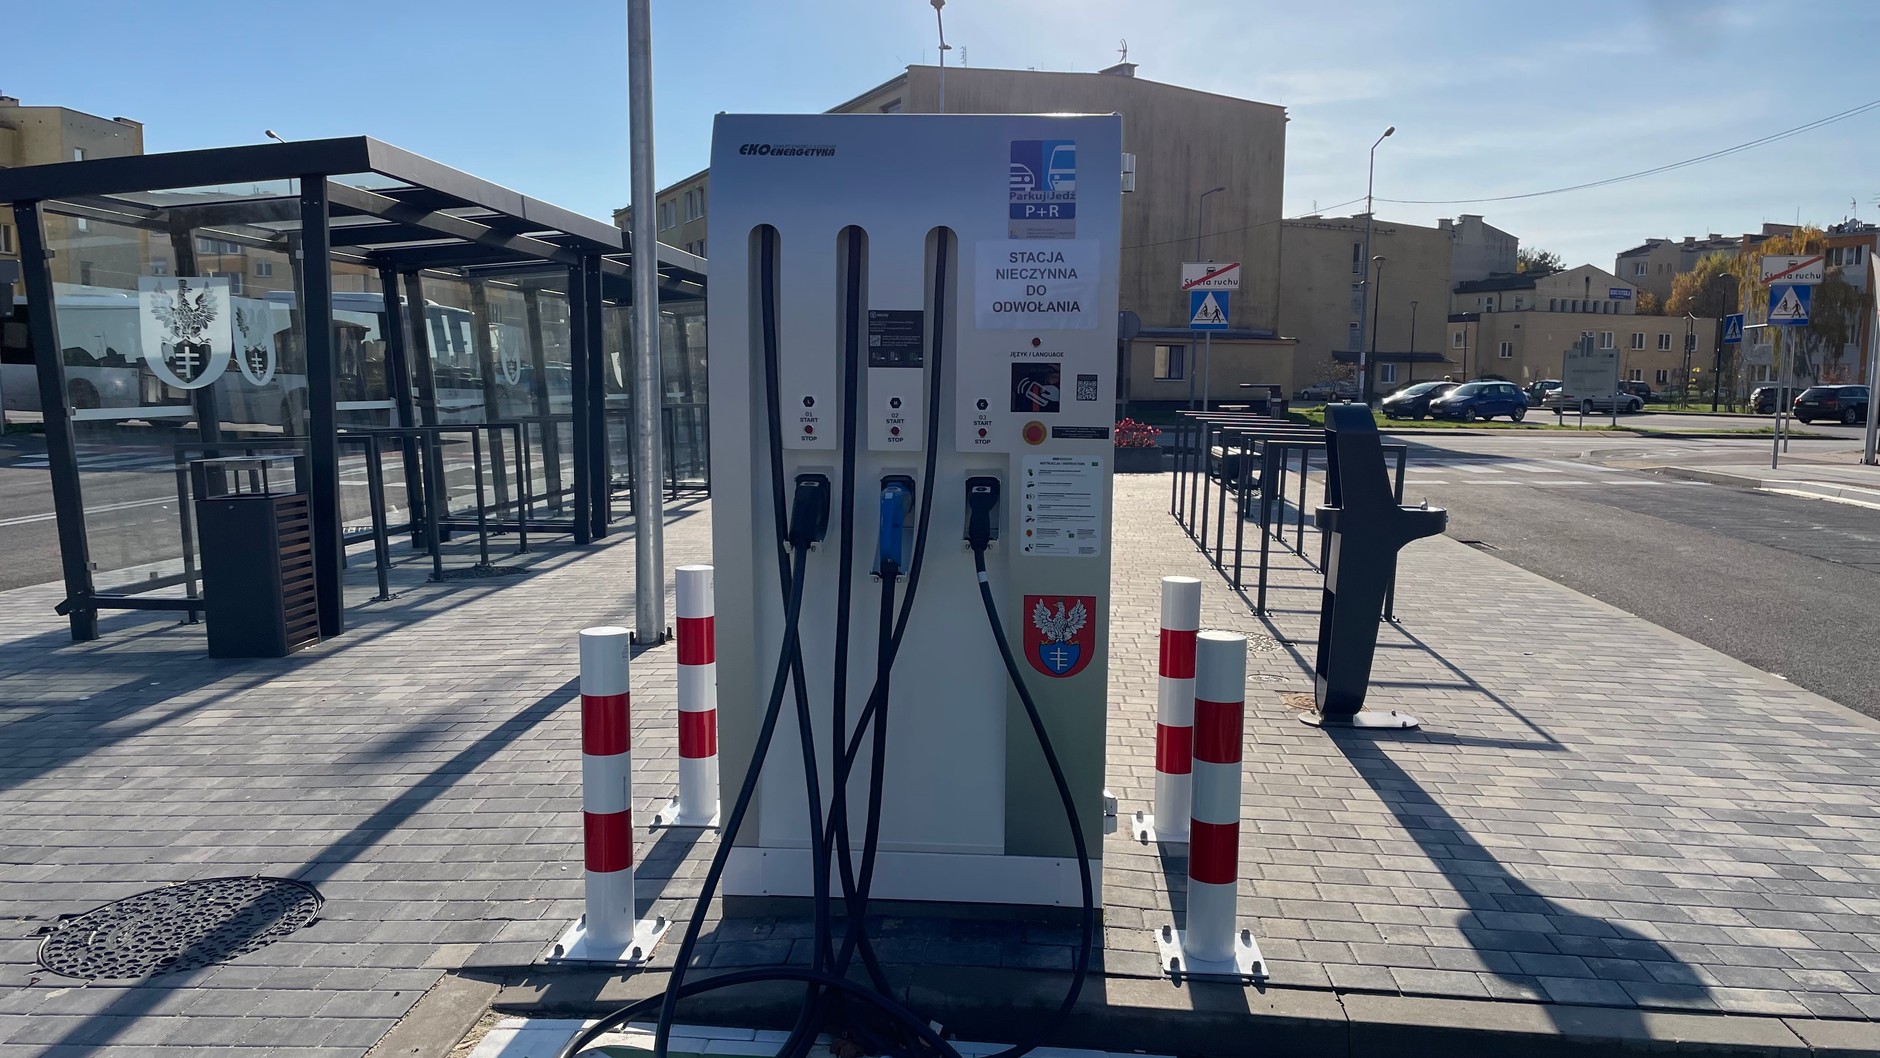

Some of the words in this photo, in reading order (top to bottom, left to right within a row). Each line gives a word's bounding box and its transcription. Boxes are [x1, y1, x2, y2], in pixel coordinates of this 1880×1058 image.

[1010, 191, 1046, 202] Parkuj
[1025, 205, 1059, 217] P+R
[1009, 252, 1065, 263] STACJA
[996, 268, 1078, 280] NIECZYNNA
[1214, 278, 1238, 286] ruchu
[1026, 284, 1047, 296] DO
[992, 301, 1080, 312] ODWOŁANIA
